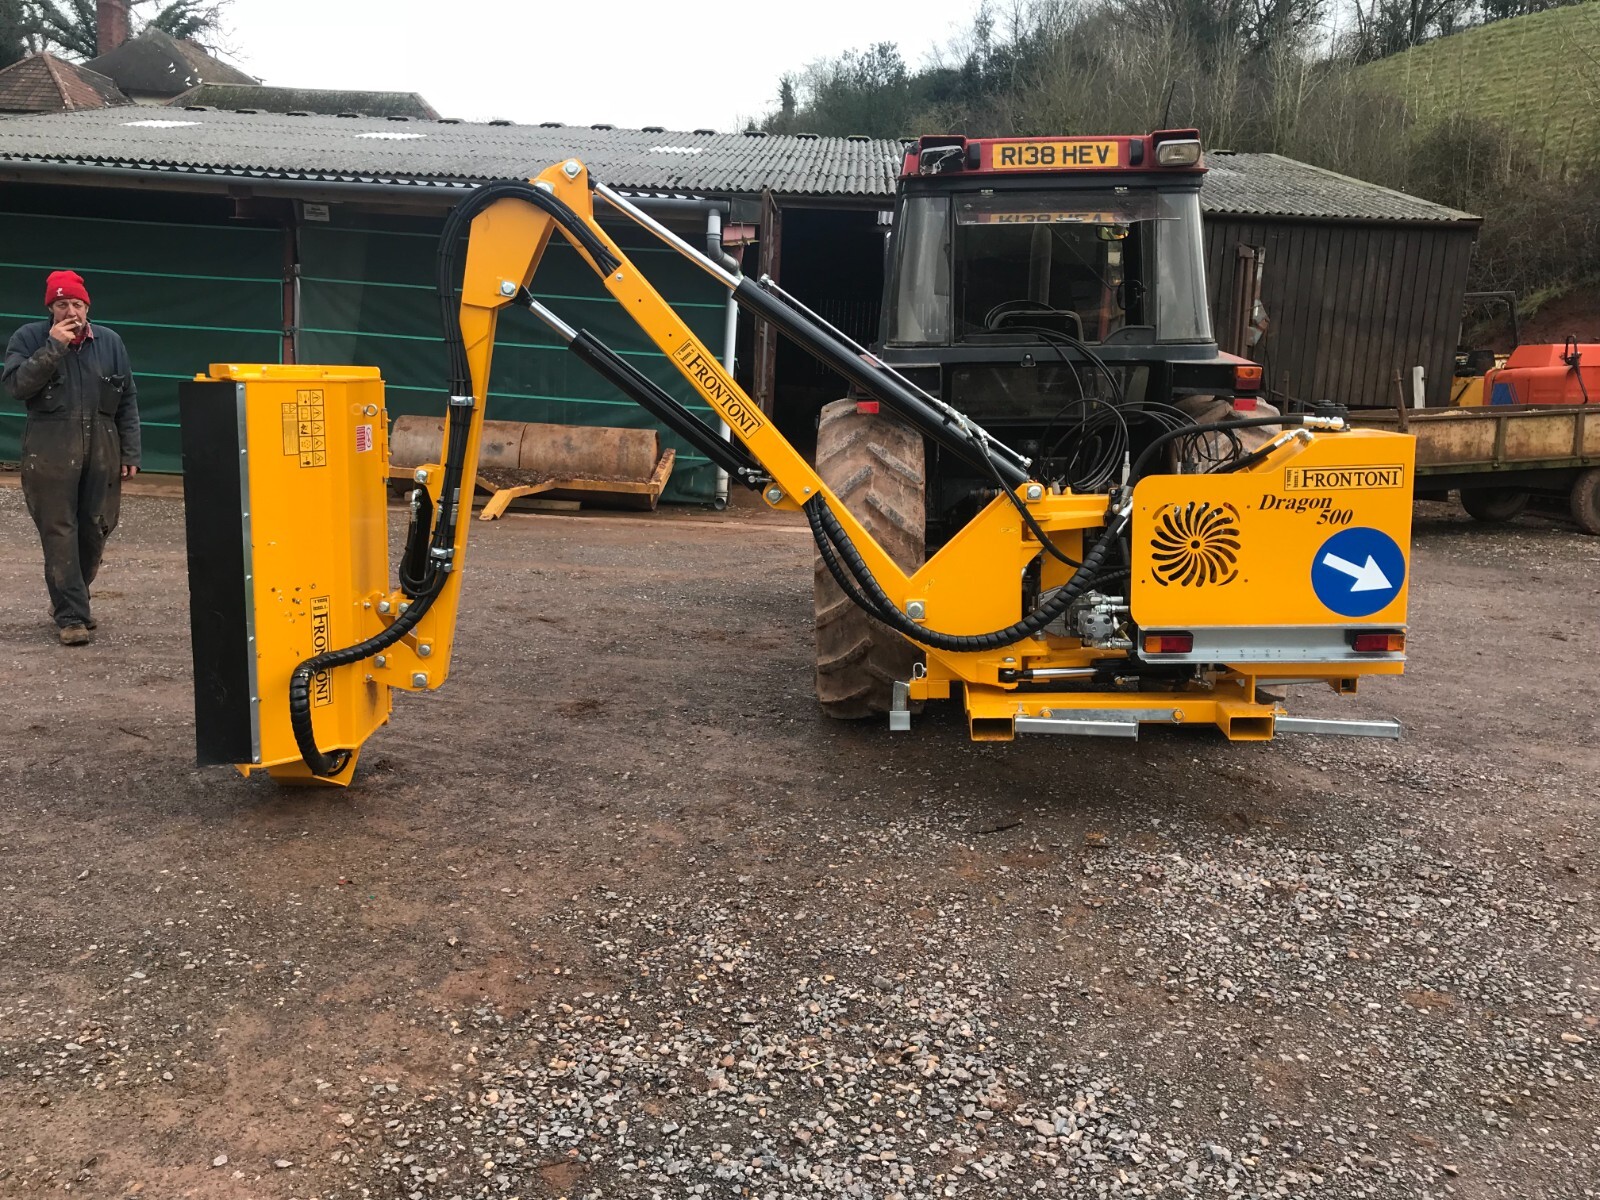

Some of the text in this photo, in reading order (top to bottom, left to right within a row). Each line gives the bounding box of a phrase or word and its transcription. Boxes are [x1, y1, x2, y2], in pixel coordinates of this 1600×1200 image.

[1001, 144, 1110, 166] R138 HEV
[687, 353, 761, 433] FRONTONI
[1301, 466, 1402, 488] FRONTONI
[1258, 494, 1333, 514] Dragon
[1316, 509, 1354, 525] 500
[313, 611, 331, 703] FRONONI
